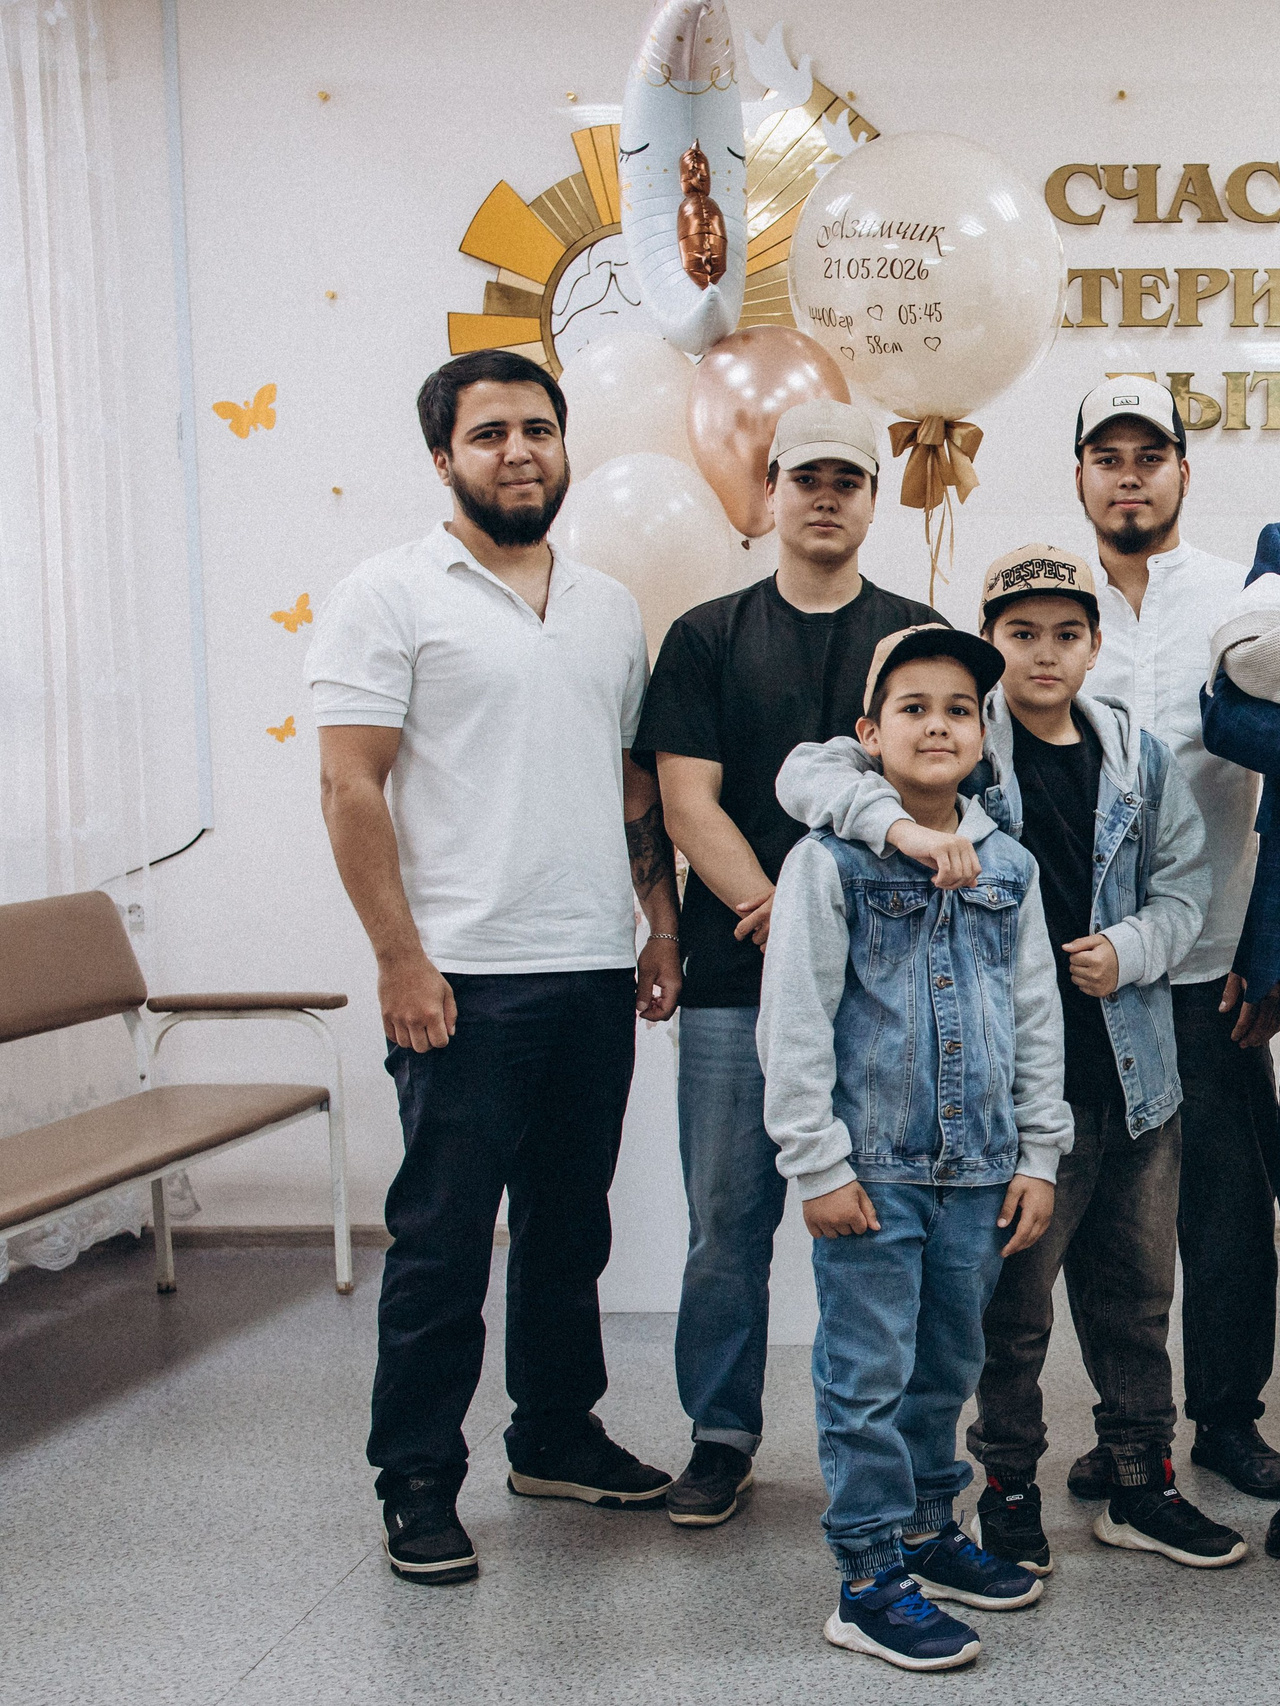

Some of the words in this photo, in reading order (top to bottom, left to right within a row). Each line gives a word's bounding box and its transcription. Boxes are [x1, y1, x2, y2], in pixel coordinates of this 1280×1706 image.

[817, 209, 946, 257] Азимчик
[823, 256, 929, 280] 21.05.2026
[898, 302, 942, 325] 05:45
[1001, 558, 1077, 592] RESPECT
